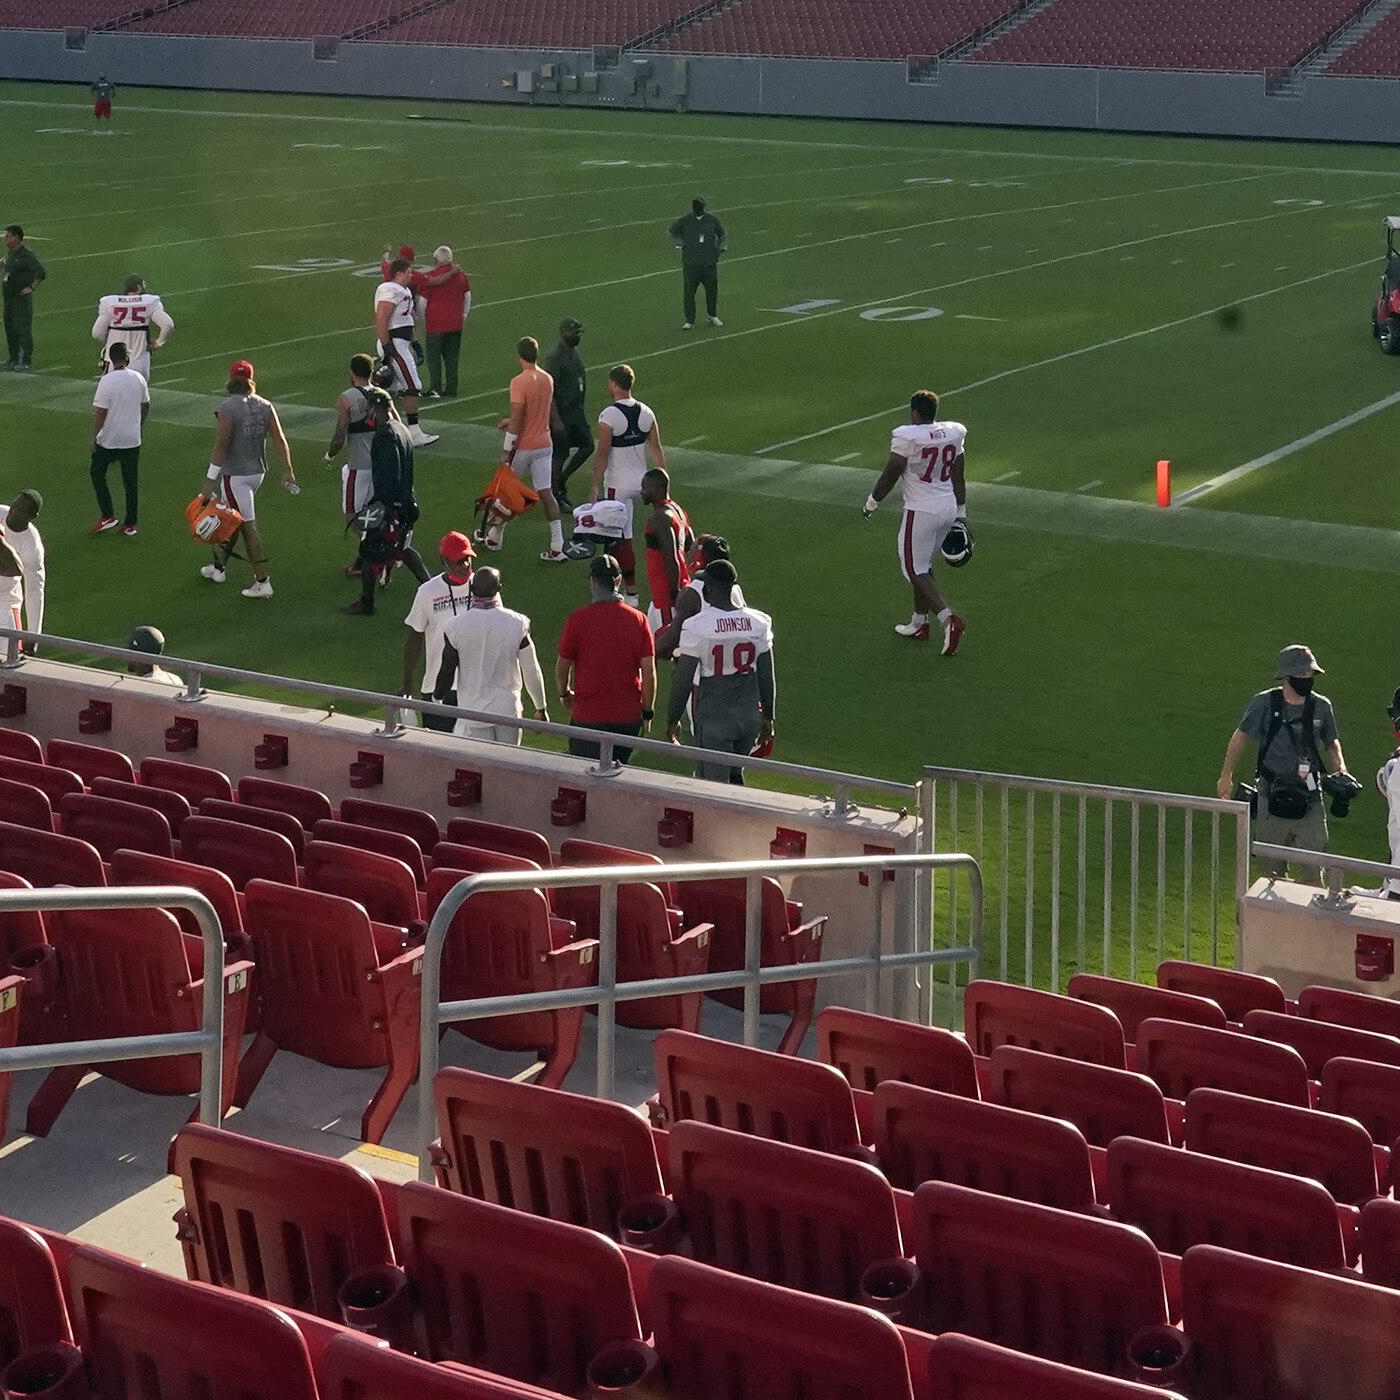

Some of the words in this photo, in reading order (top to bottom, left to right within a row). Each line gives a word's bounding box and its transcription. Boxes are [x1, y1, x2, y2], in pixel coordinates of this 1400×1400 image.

[113, 306, 147, 325] 75
[919, 444, 957, 484] 78
[714, 617, 752, 633] JOHNSON
